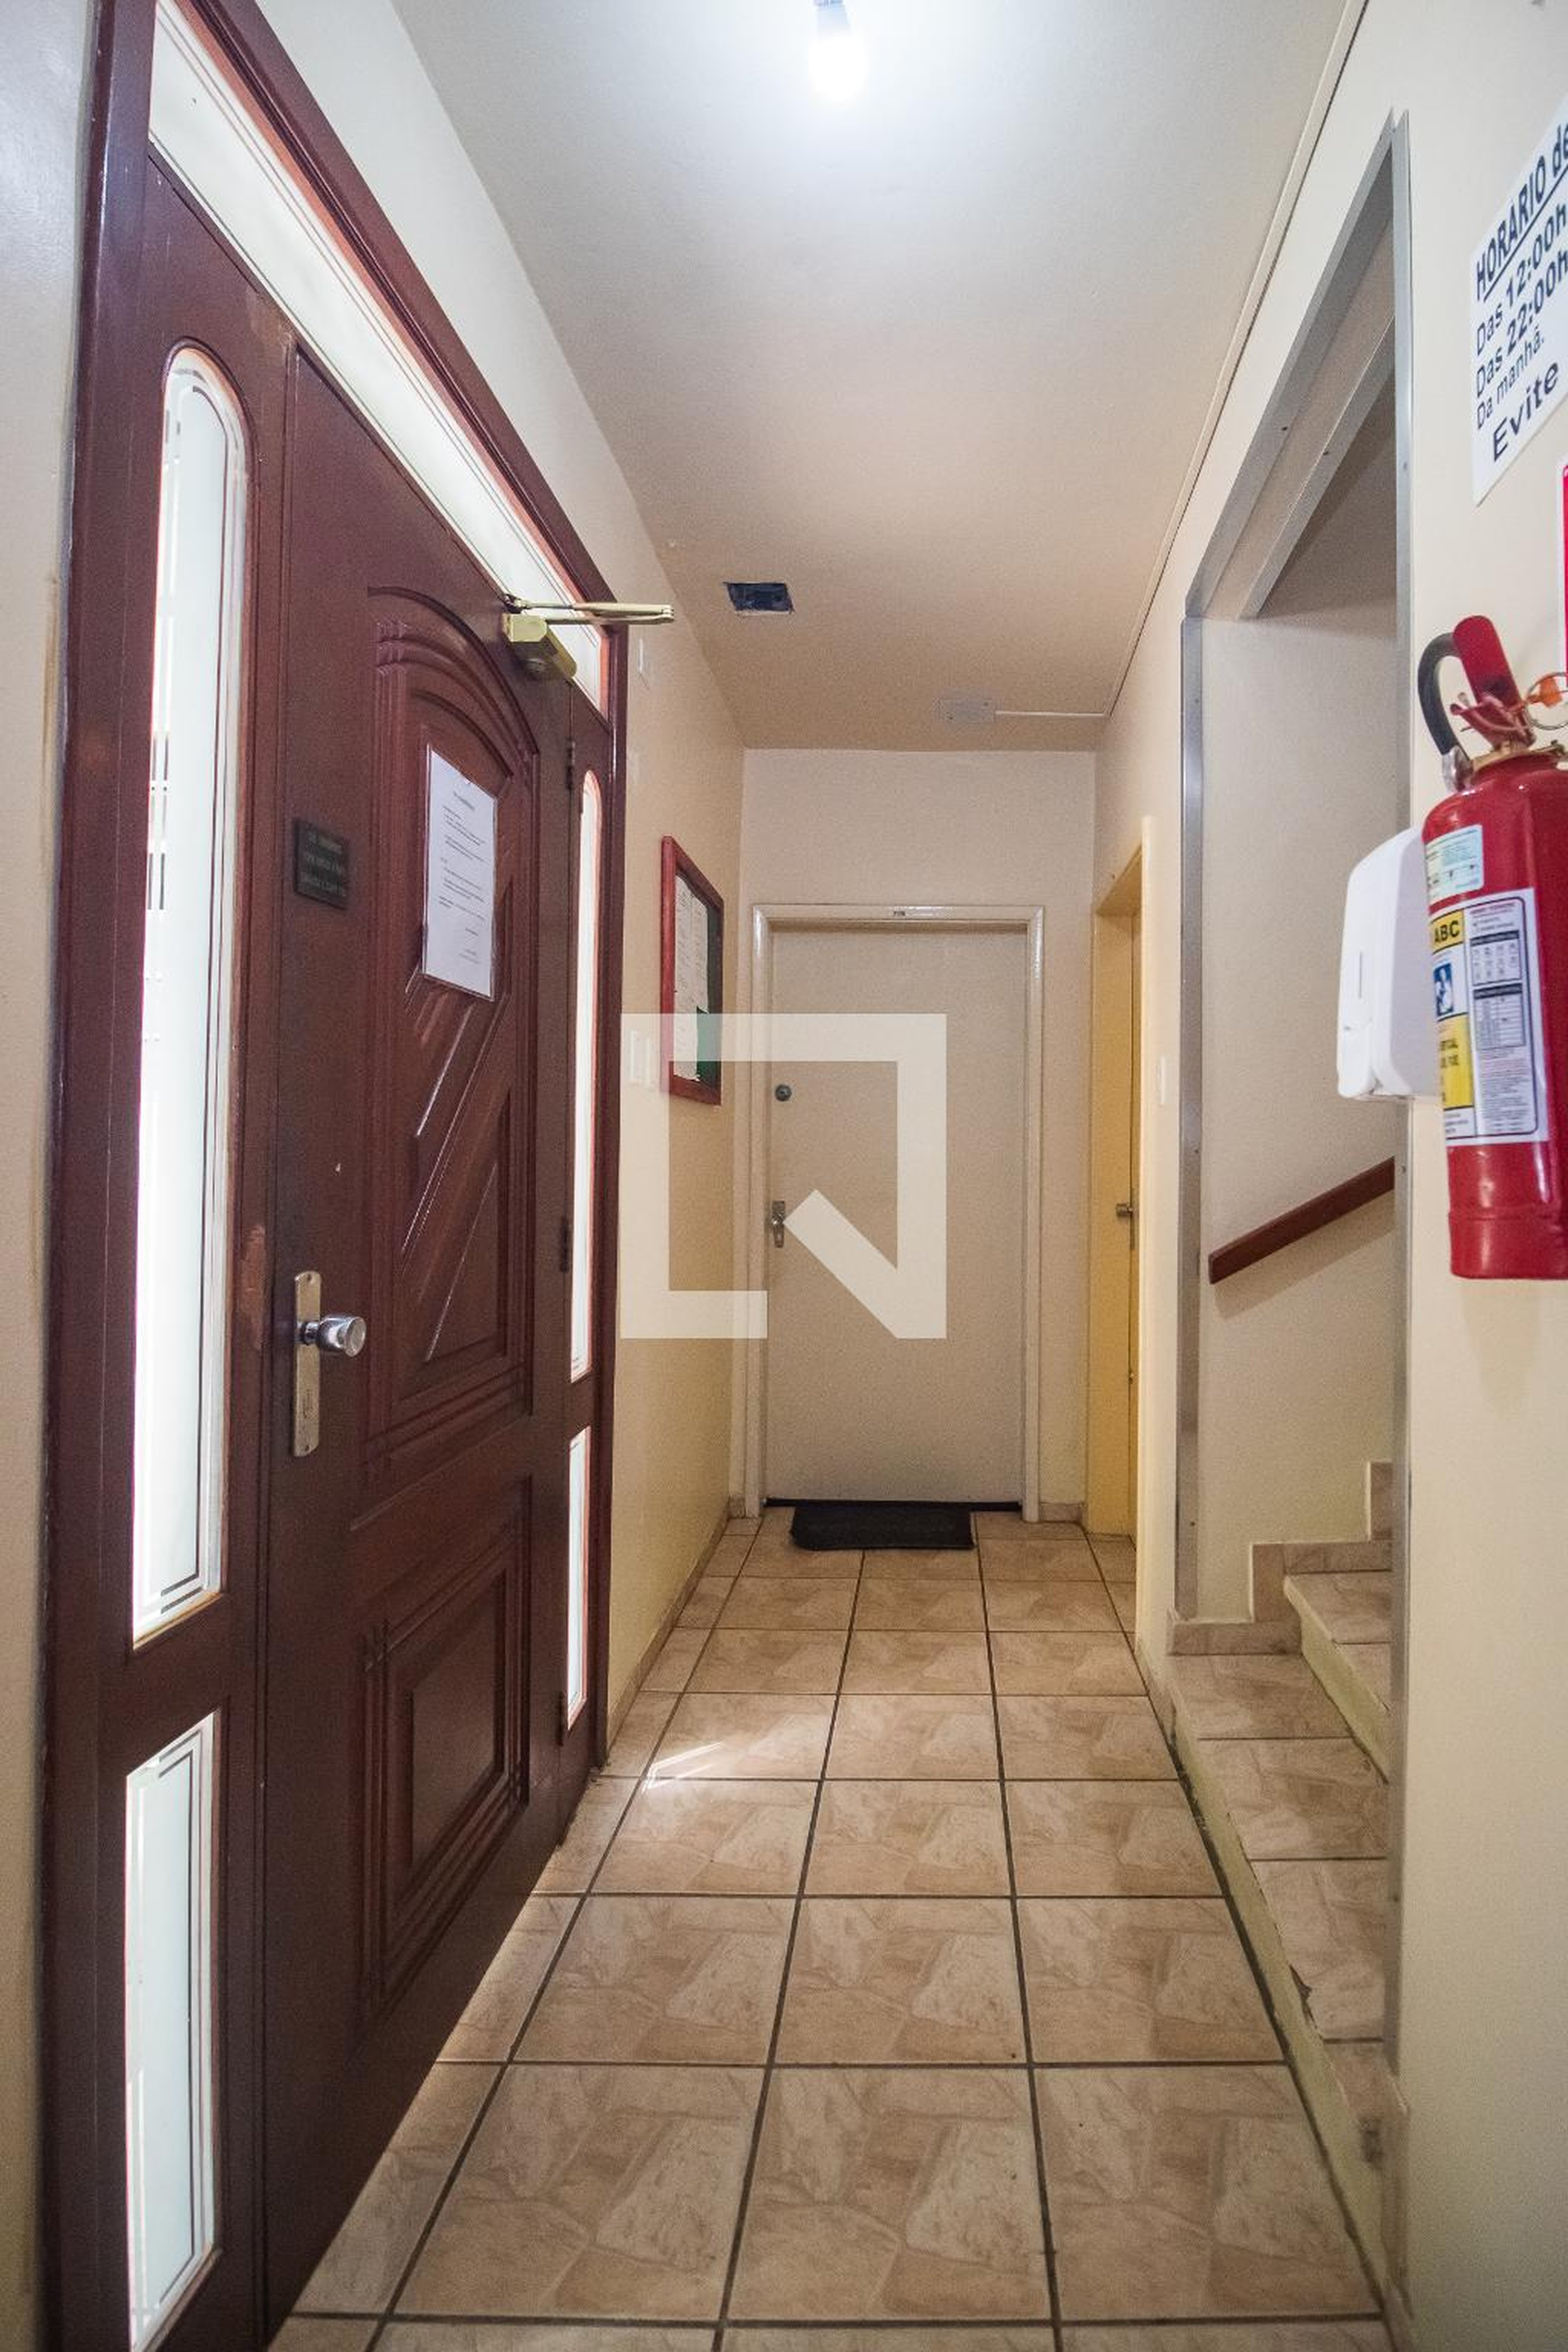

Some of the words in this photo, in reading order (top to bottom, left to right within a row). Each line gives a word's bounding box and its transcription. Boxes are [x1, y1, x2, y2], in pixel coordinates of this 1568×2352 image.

[1477, 303, 1503, 356] Das
[1506, 204, 1566, 308] 12:00h
[1477, 347, 1503, 398] Das
[1507, 249, 1568, 355] 22:00h
[1477, 396, 1493, 429] Da
[1493, 362, 1558, 462] Evite
[1434, 920, 1460, 943] ABC
